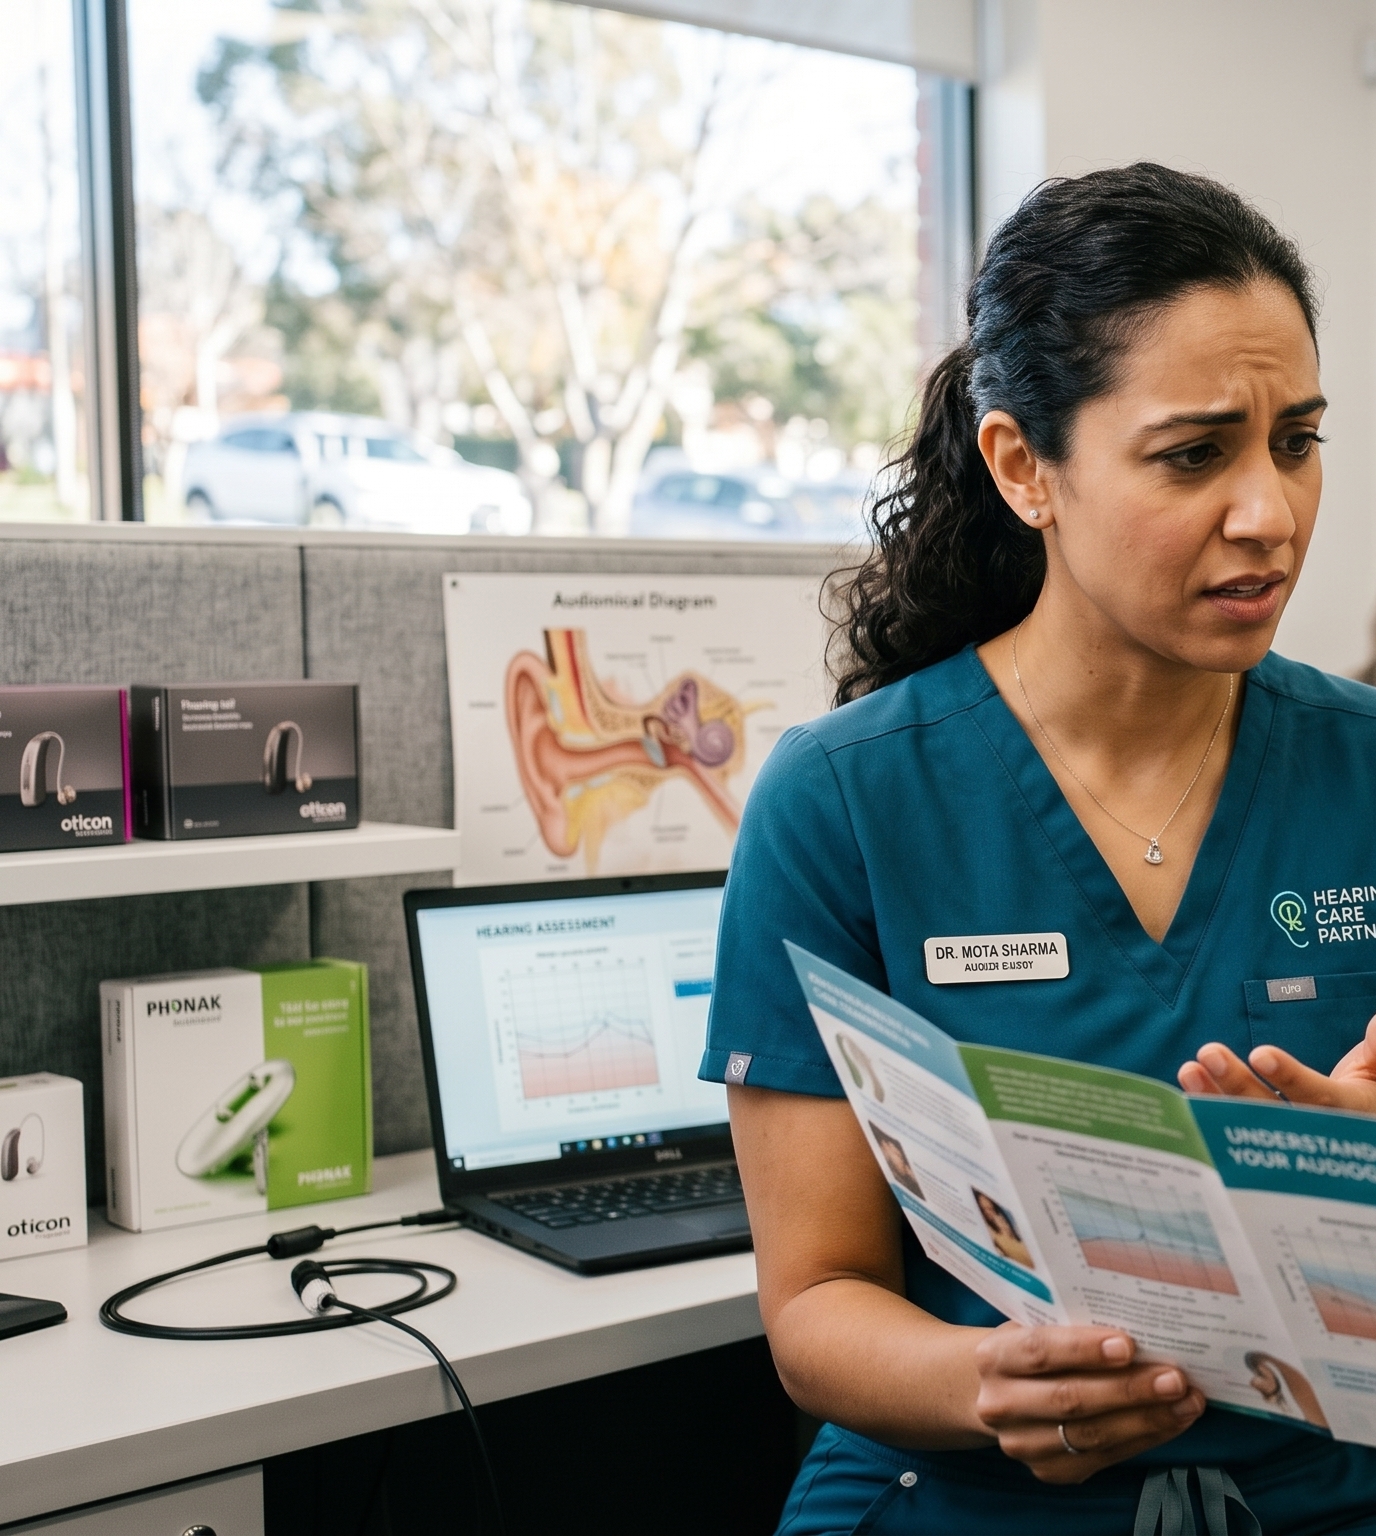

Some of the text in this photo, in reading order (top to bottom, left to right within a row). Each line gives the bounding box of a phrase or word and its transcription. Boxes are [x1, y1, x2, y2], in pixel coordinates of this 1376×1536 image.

[649, 591, 716, 613] Diagram
[299, 801, 346, 818] oticon
[61, 814, 112, 831] oticon
[1315, 905, 1365, 925] CARE
[476, 915, 615, 938] HEARING ASSESSMENT
[936, 941, 1058, 960] DR. MOTA SHARMA
[147, 994, 222, 1017] PHONAK
[1228, 1146, 1292, 1171] YOUR
[298, 1164, 352, 1187] PHONAK
[7, 1216, 71, 1238] oticon
